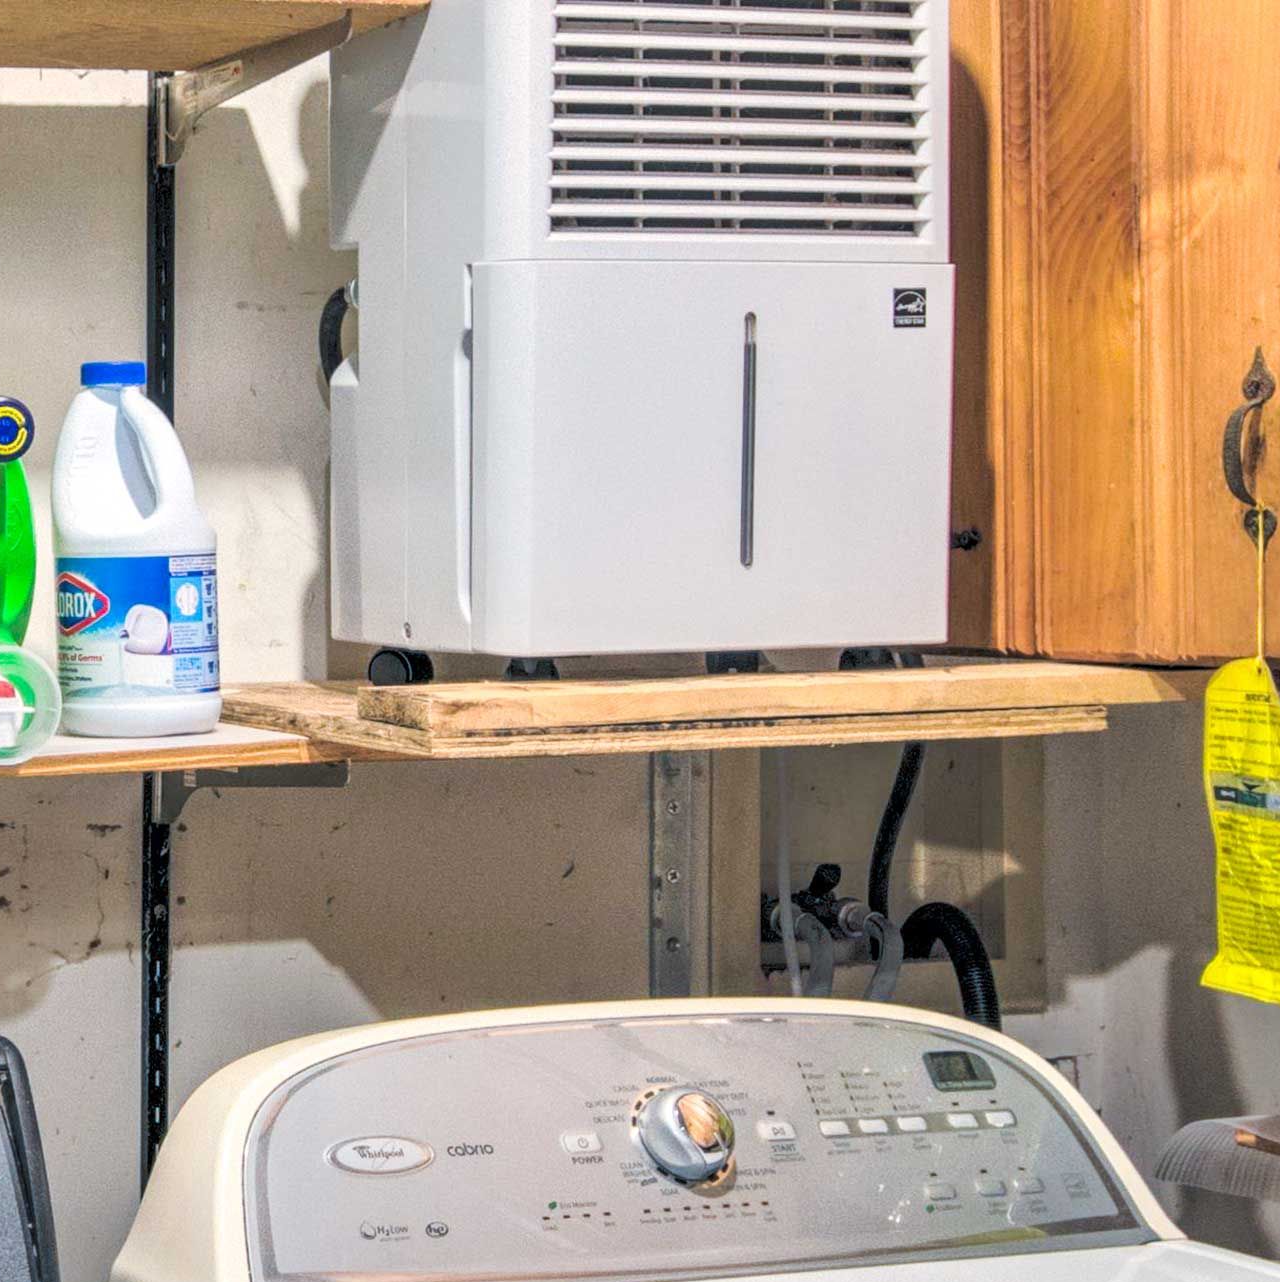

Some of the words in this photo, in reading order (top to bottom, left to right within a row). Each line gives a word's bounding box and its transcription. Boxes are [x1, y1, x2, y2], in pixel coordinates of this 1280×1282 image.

[356, 1146, 405, 1161] Whirlpool
[447, 1143, 494, 1157] cabrio
[571, 1156, 604, 1165] POWER
